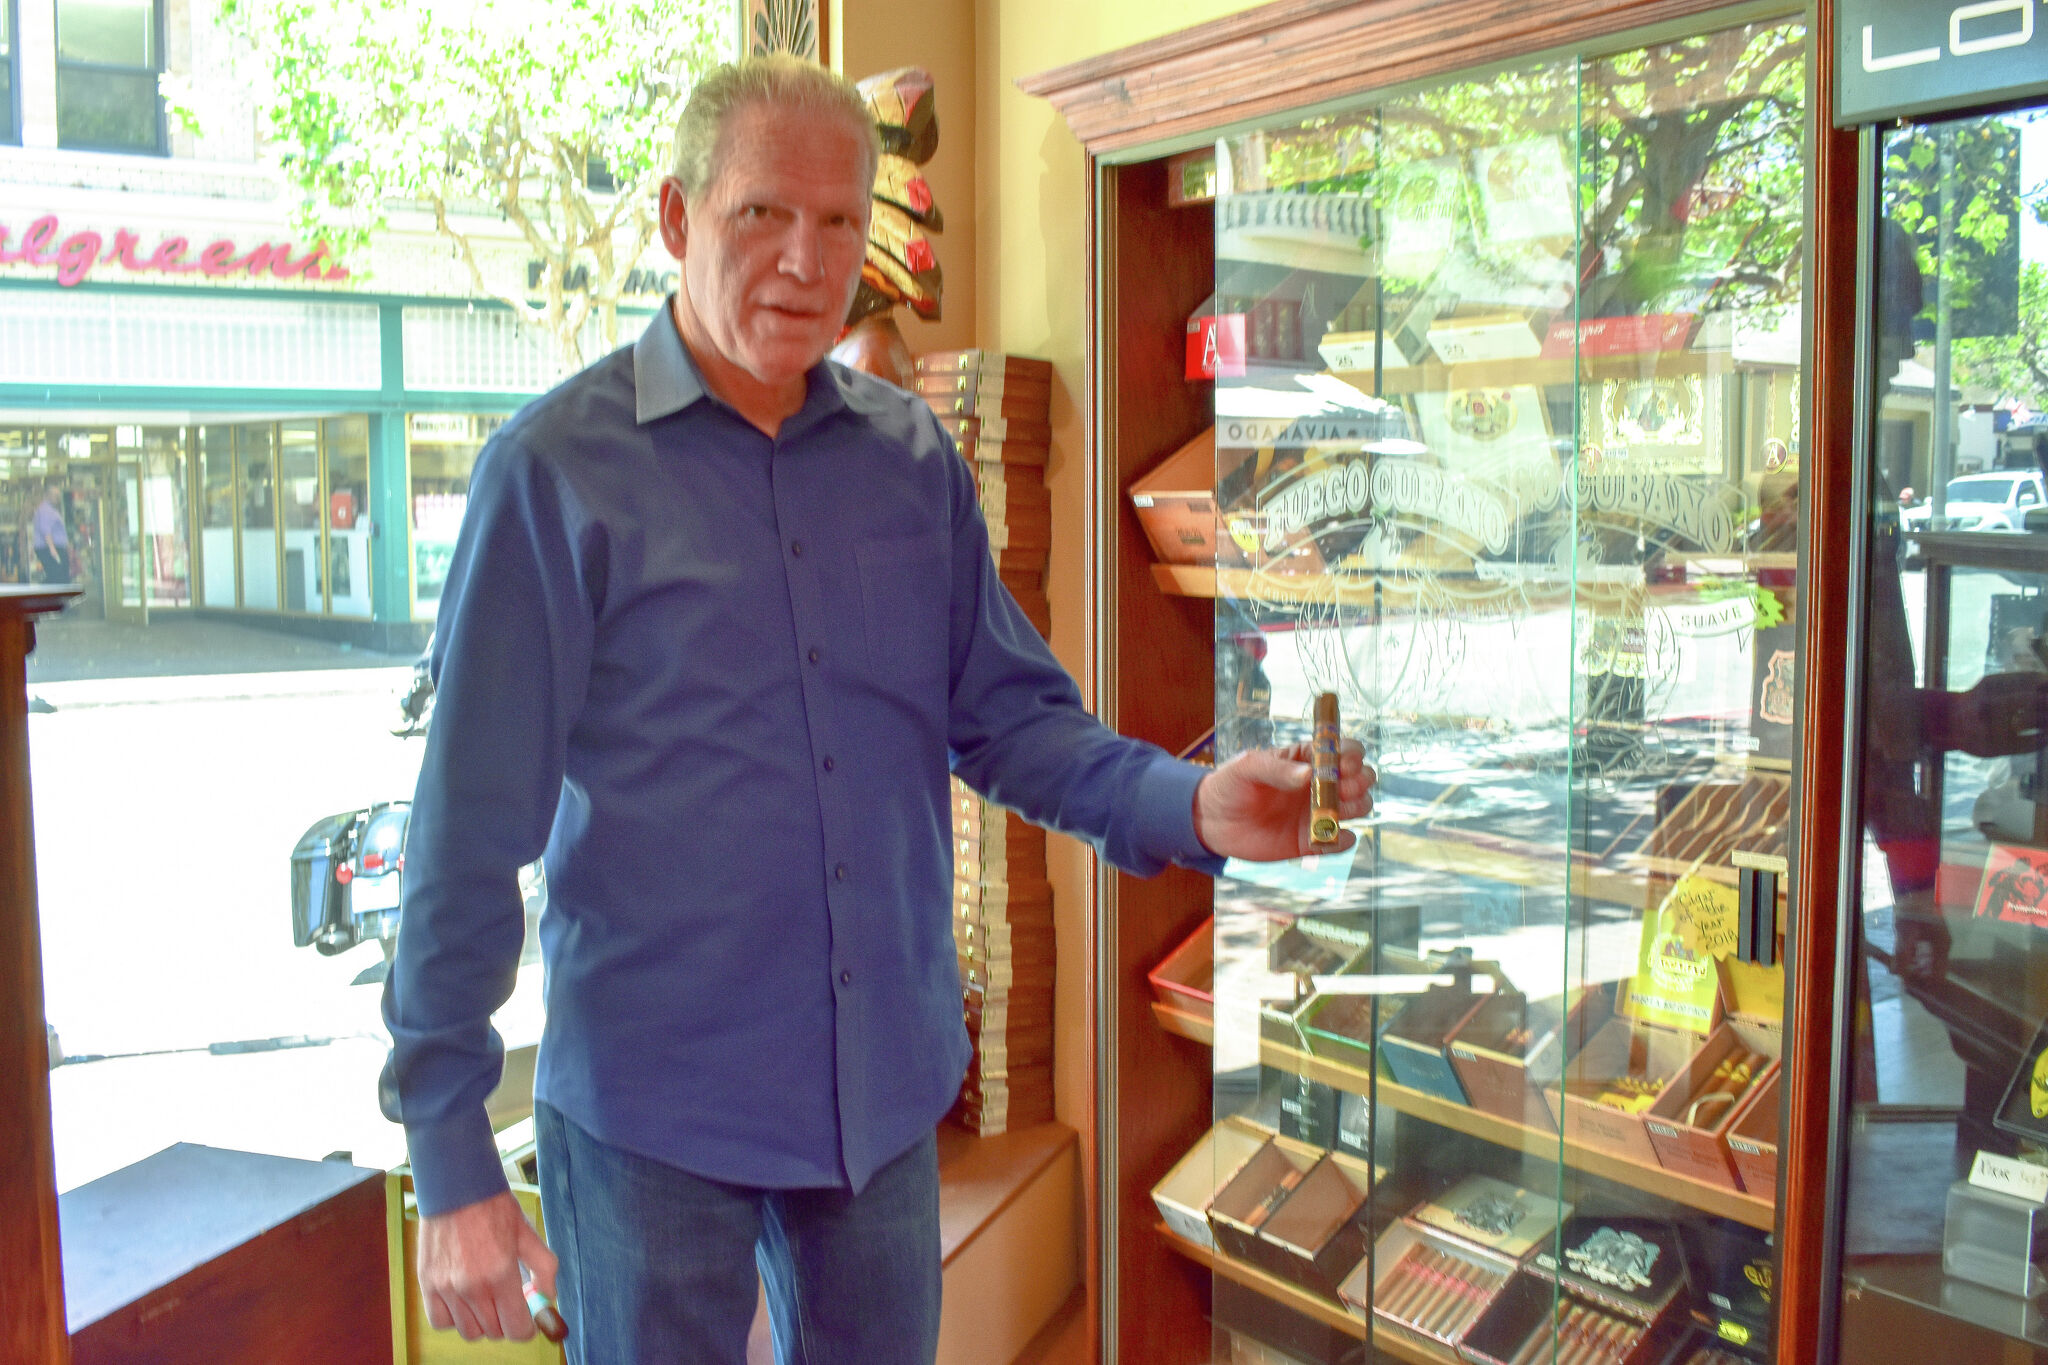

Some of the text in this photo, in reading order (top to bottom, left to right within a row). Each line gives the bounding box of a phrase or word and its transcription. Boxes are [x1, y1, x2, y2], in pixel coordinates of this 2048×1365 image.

[1862, 0, 2048, 73] LO
[0, 214, 350, 287] lgreens
[1263, 458, 1369, 553] FUEGO
[1370, 457, 1509, 556] CUBANO
[1563, 456, 1734, 554] CUBANO
[1681, 604, 1742, 627] SUAVE
